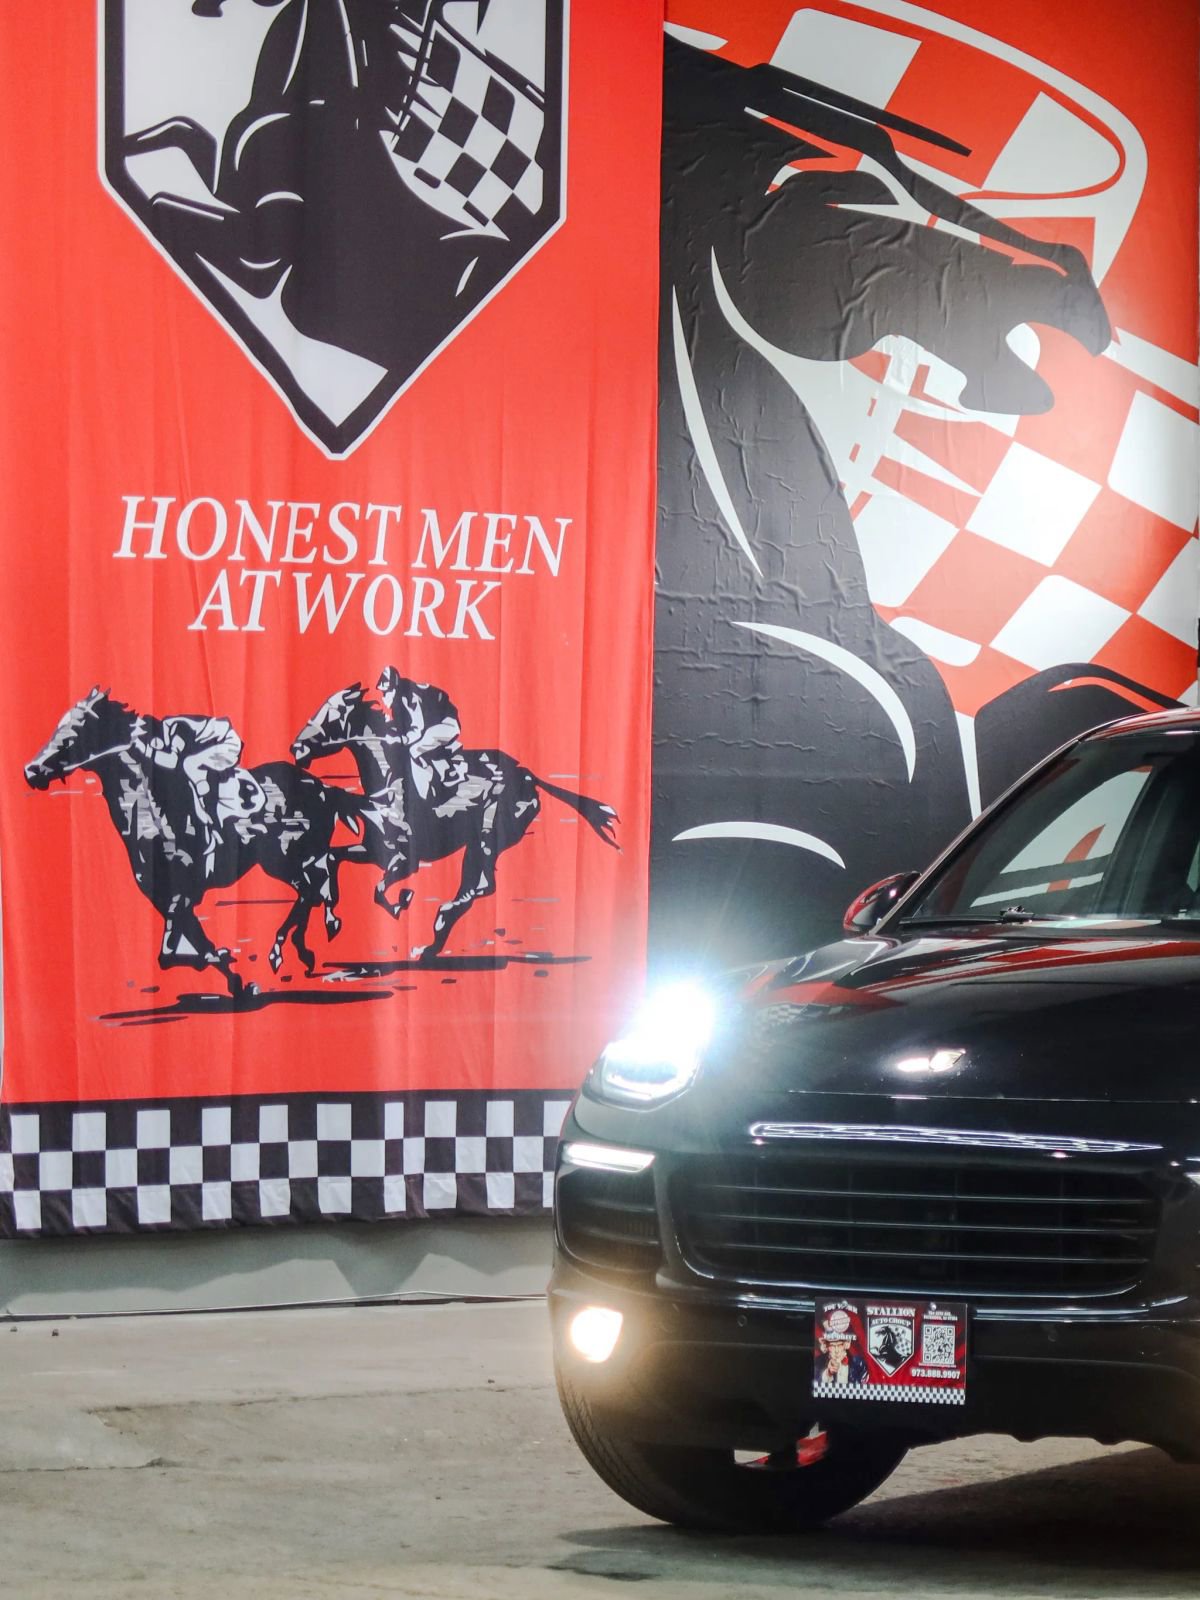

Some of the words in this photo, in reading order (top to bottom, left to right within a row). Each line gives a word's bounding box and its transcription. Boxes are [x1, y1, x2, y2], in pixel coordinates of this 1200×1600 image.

[112, 495, 402, 566] HONEST
[411, 508, 573, 577] MEN
[187, 569, 282, 632] AT
[292, 572, 501, 640] WORK
[867, 1306, 916, 1317] STALLION
[872, 1317, 888, 1325] AUTO
[889, 1317, 912, 1326] GROUP
